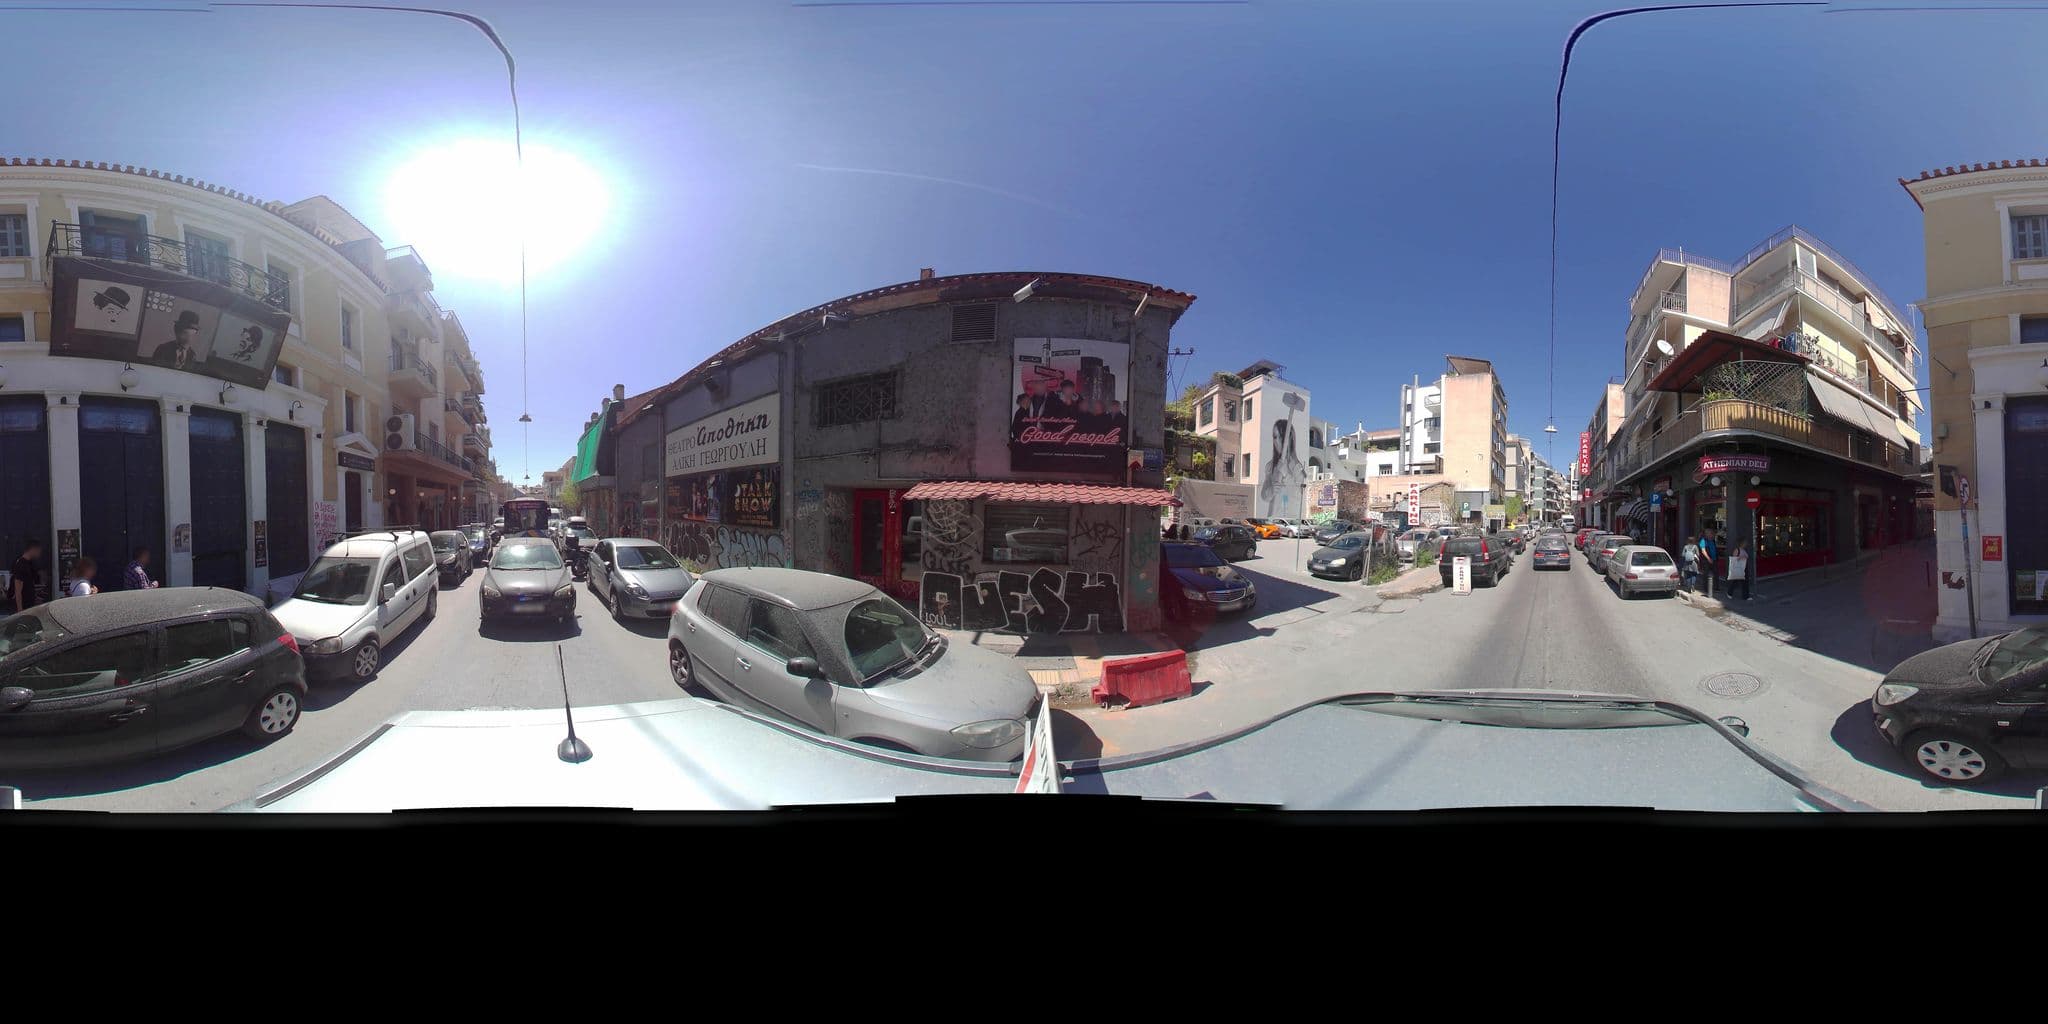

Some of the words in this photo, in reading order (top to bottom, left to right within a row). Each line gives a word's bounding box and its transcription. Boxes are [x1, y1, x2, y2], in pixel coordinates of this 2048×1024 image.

[668, 436, 696, 455] ΘΕΑΤΡΟ
[1021, 424, 1074, 444] Good
[1066, 427, 1121, 446] people
[672, 454, 696, 471] ΑΛΙΚΗ
[700, 437, 768, 466] ΓΕΩΡΓΟΥΛΗ
[1703, 459, 1747, 470] ATHENIAN
[1749, 460, 1768, 469] DELI
[1410, 483, 1419, 524] PARKING
